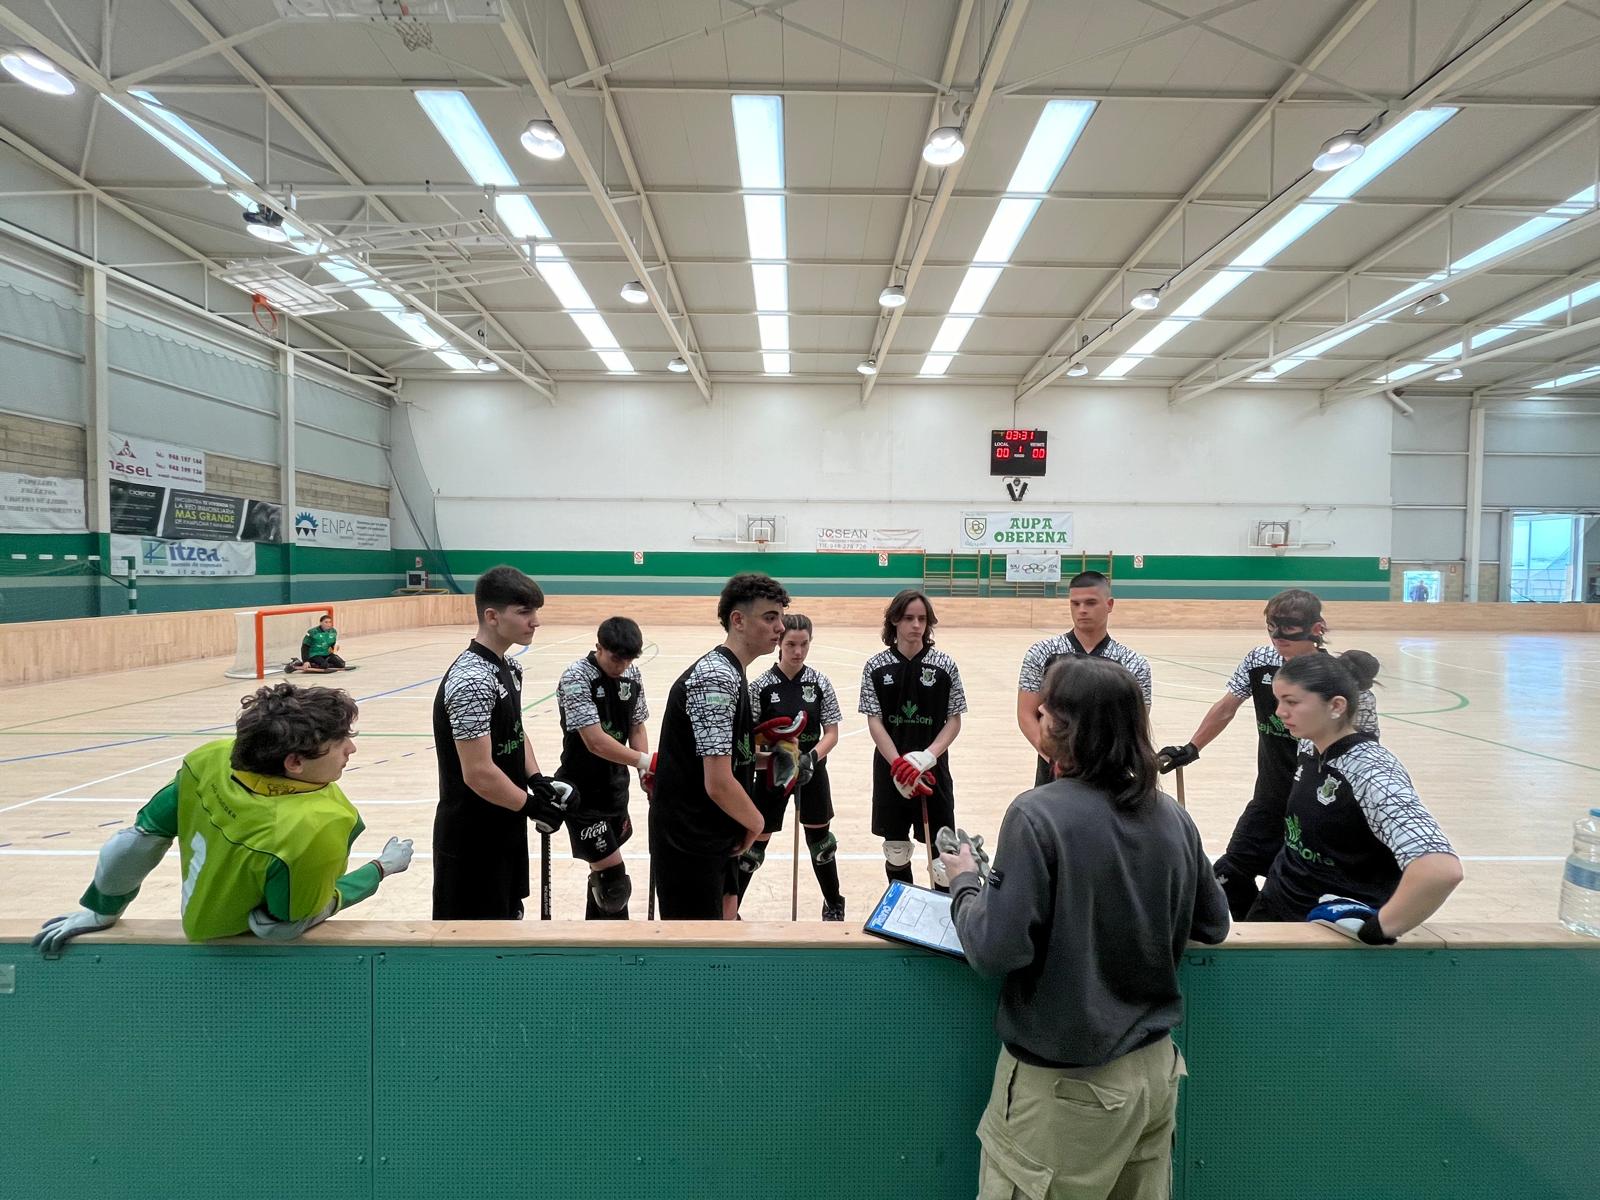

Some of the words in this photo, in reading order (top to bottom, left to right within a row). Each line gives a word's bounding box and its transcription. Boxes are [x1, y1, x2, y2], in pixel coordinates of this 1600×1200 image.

[1006, 430, 1034, 440] 03:31
[996, 448, 1010, 458] 00
[1032, 448, 1046, 459] 00
[175, 509, 197, 520] MAS
[199, 511, 236, 524] GRANDE
[322, 518, 354, 535] ENPA
[1009, 518, 1053, 530] AUPA
[818, 528, 868, 539] JOSEAN
[994, 531, 1067, 543] OBERENA
